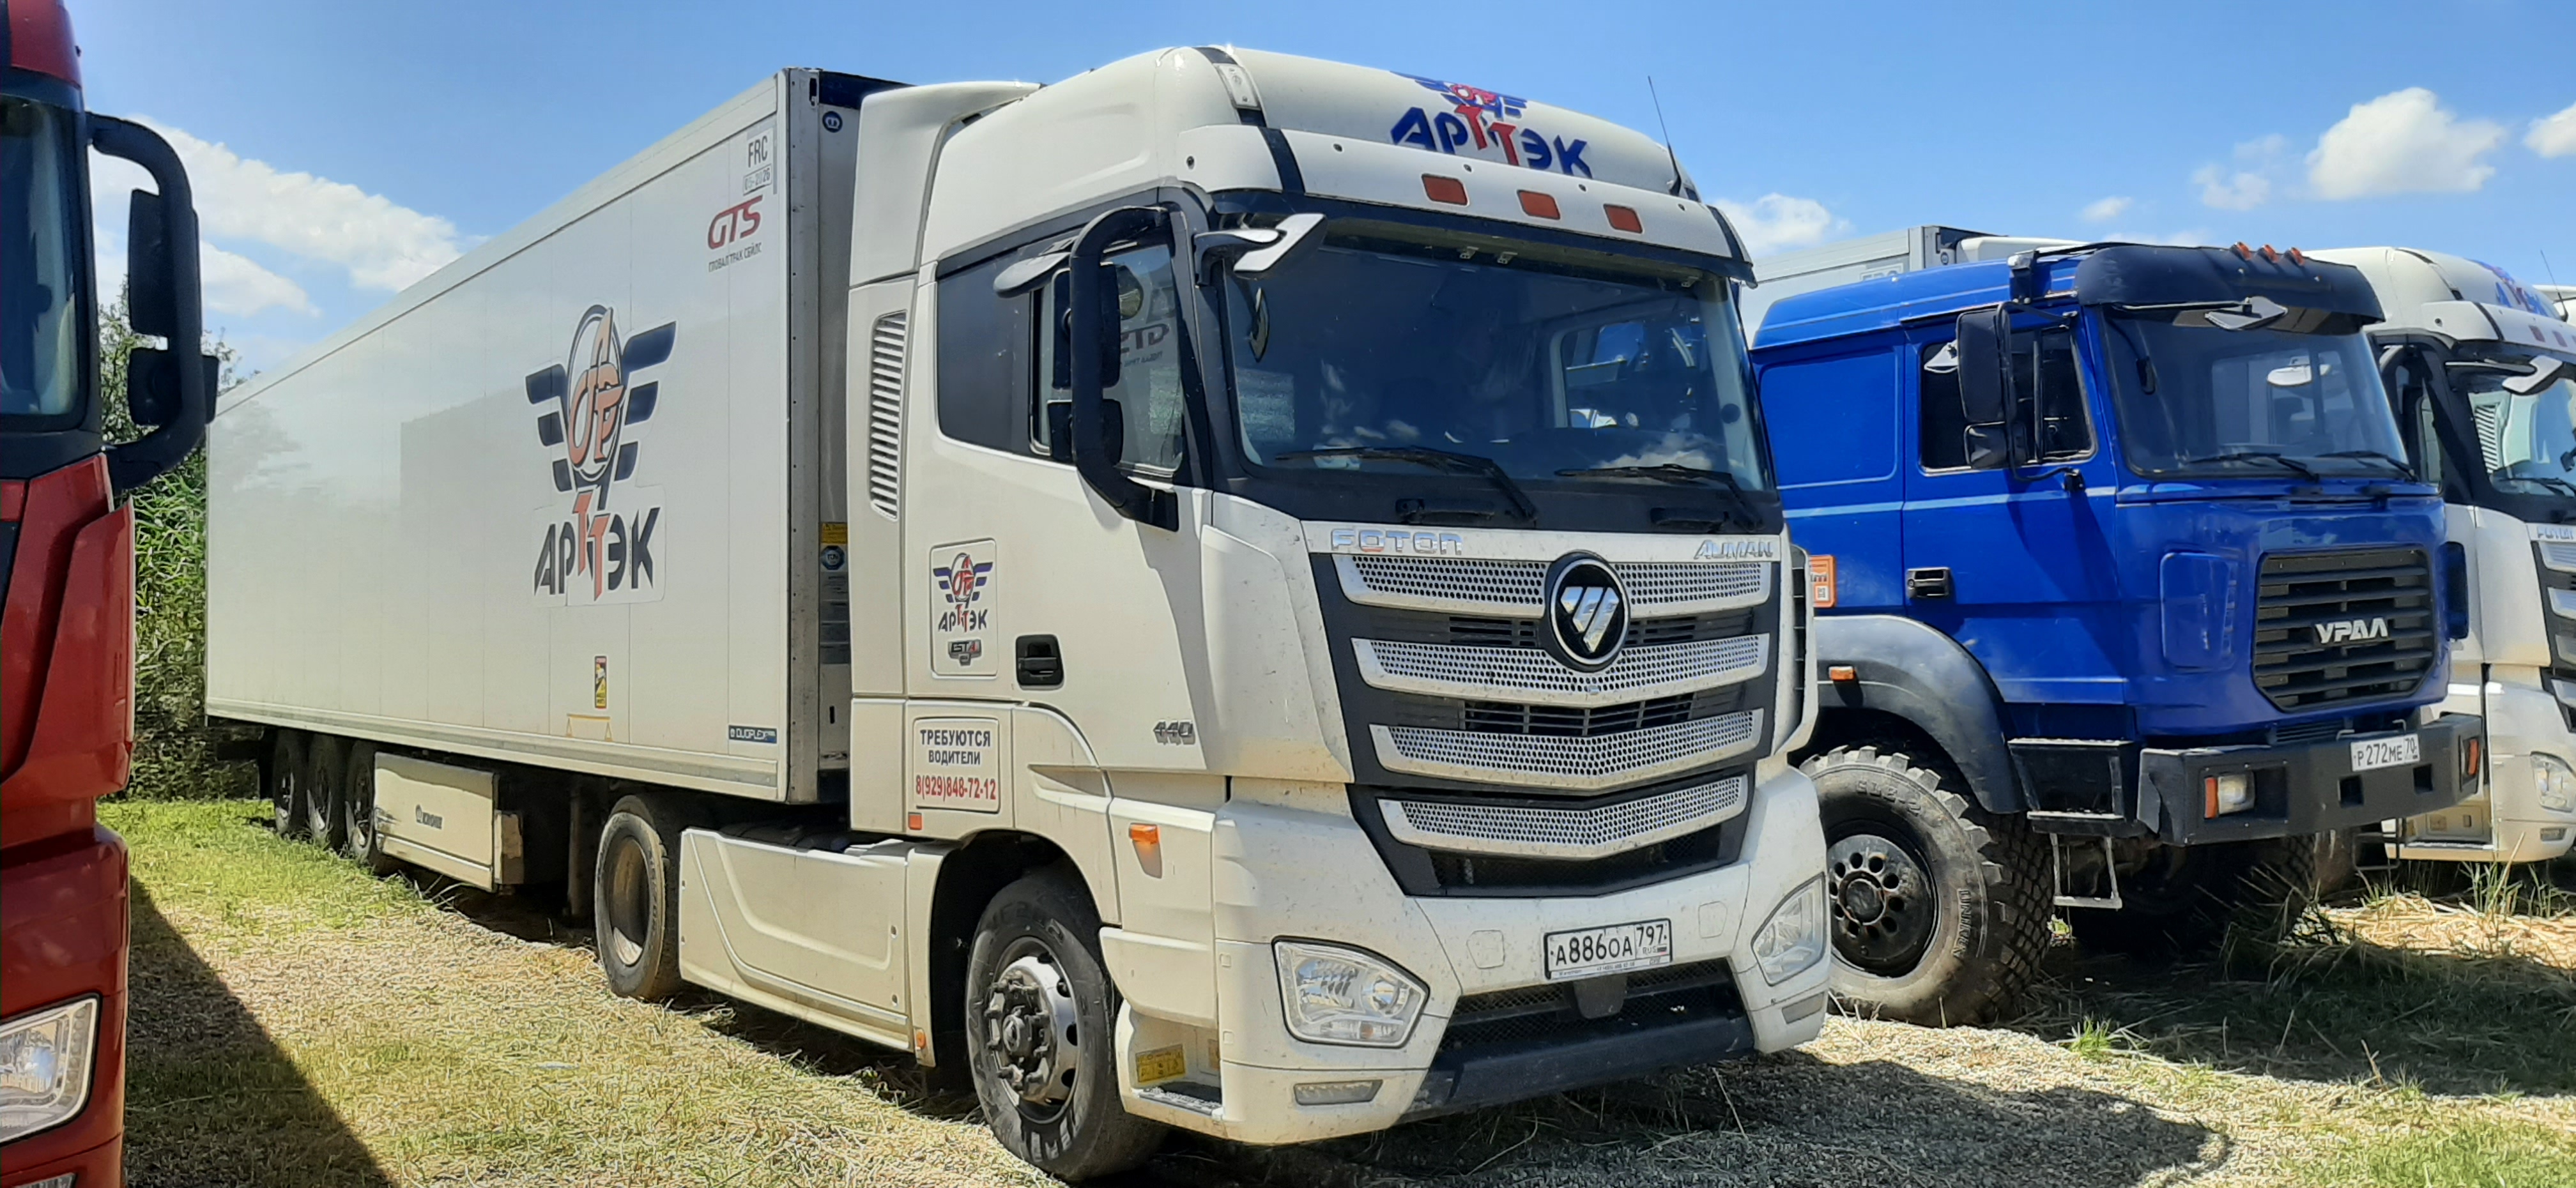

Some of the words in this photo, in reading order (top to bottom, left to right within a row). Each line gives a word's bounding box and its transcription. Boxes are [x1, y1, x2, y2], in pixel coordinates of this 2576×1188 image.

[747, 135, 769, 168] FRC
[707, 194, 763, 250] GTS
[1331, 528, 1463, 556] FOTON
[1694, 539, 1774, 560] AUMAN
[2315, 617, 2389, 644] УРАЛ
[920, 729, 991, 747] ТРЕБУЮТСЯ
[1153, 721, 1193, 738] 440
[928, 750, 981, 766] ВОДИТЕЛИ
[916, 775, 996, 802] 8(929)848-72-12
